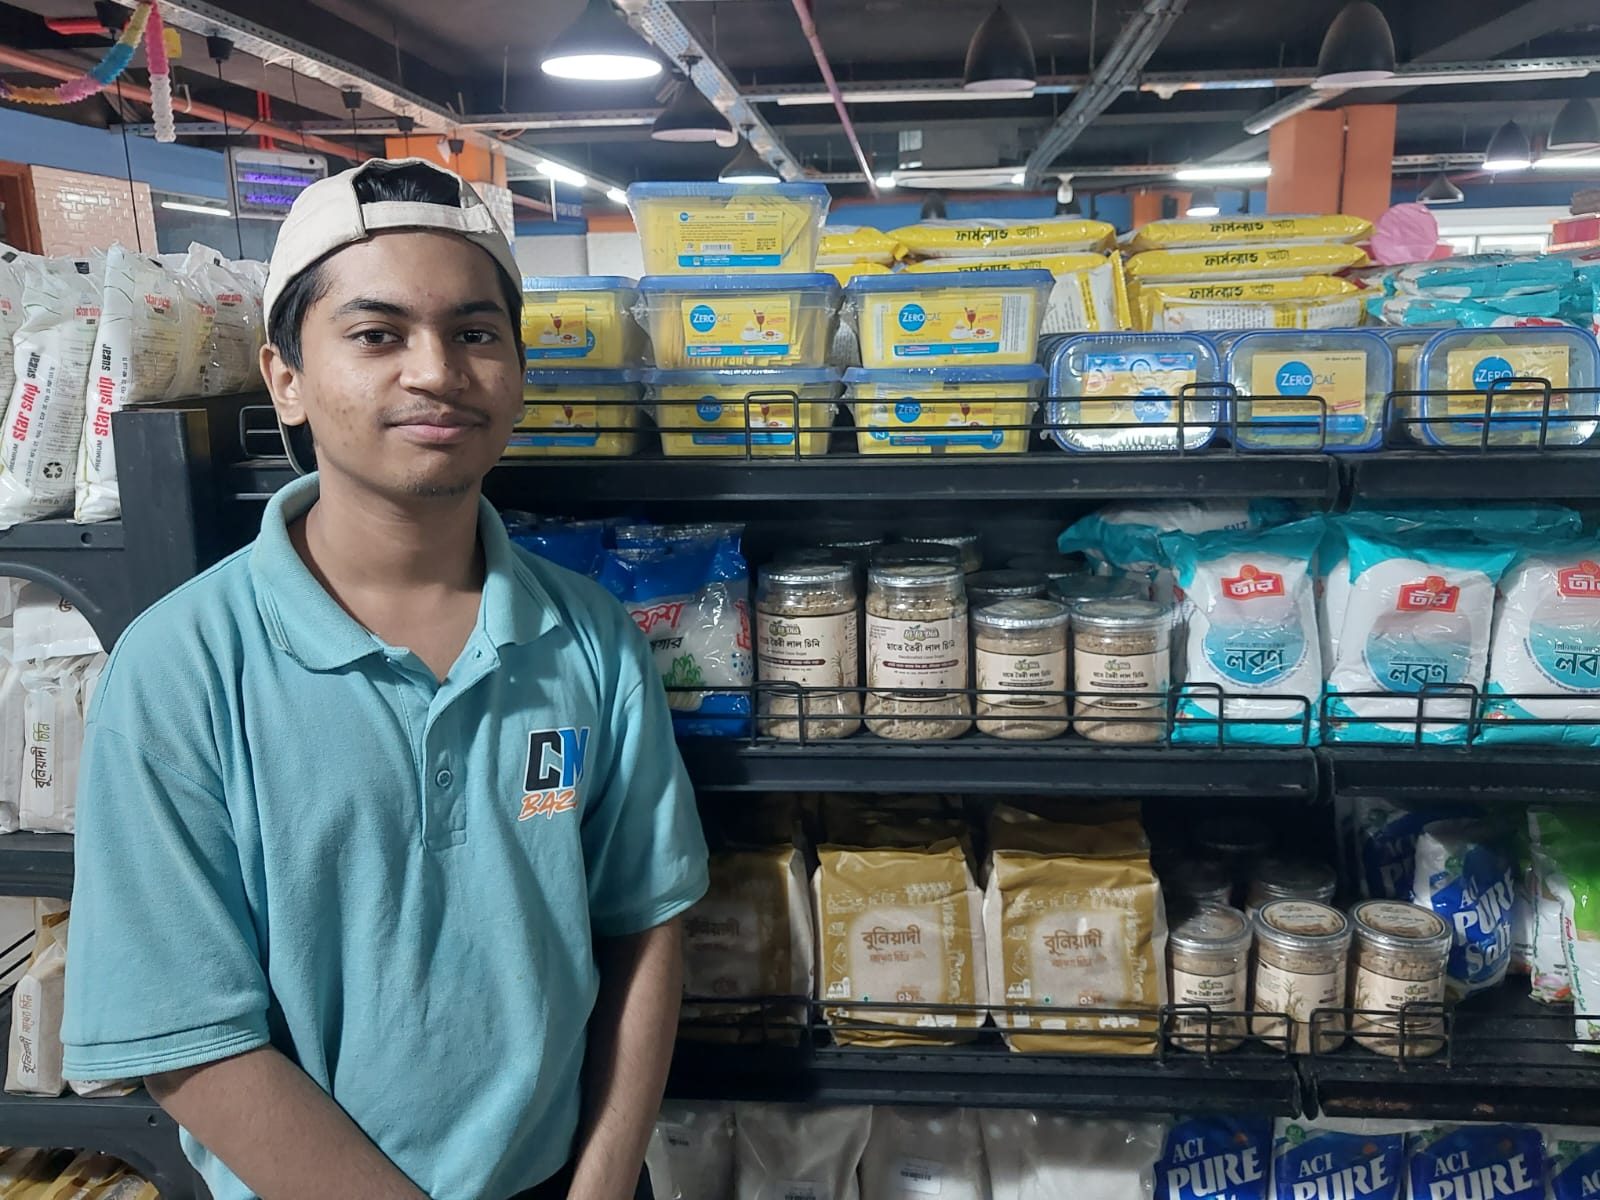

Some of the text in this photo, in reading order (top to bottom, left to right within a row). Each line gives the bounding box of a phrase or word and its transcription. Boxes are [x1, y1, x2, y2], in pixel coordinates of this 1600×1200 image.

[26, 351, 41, 379] sugar
[20, 382, 41, 412] ship
[93, 343, 116, 471] PREMIUM star ship sugar
[11, 412, 30, 442] star
[1230, 579, 1275, 596] তীর
[1409, 589, 1450, 607] তীর
[1224, 649, 1285, 671] লবণ
[1389, 662, 1449, 685] লবণ
[1555, 651, 1600, 677] লব
[861, 924, 921, 952] বুনিয়াদী
[1043, 928, 1105, 955] বুনিয়াদী
[1465, 920, 1511, 976] Salt
[1173, 1137, 1206, 1163] ACI
[1434, 1150, 1471, 1177] ACI
[1167, 1146, 1264, 1200] PURE
[1292, 1154, 1393, 1200] PURE
[1297, 1152, 1333, 1178] ACI
[1429, 1152, 1535, 1200] PURE
[1581, 1169, 1600, 1196] AC
